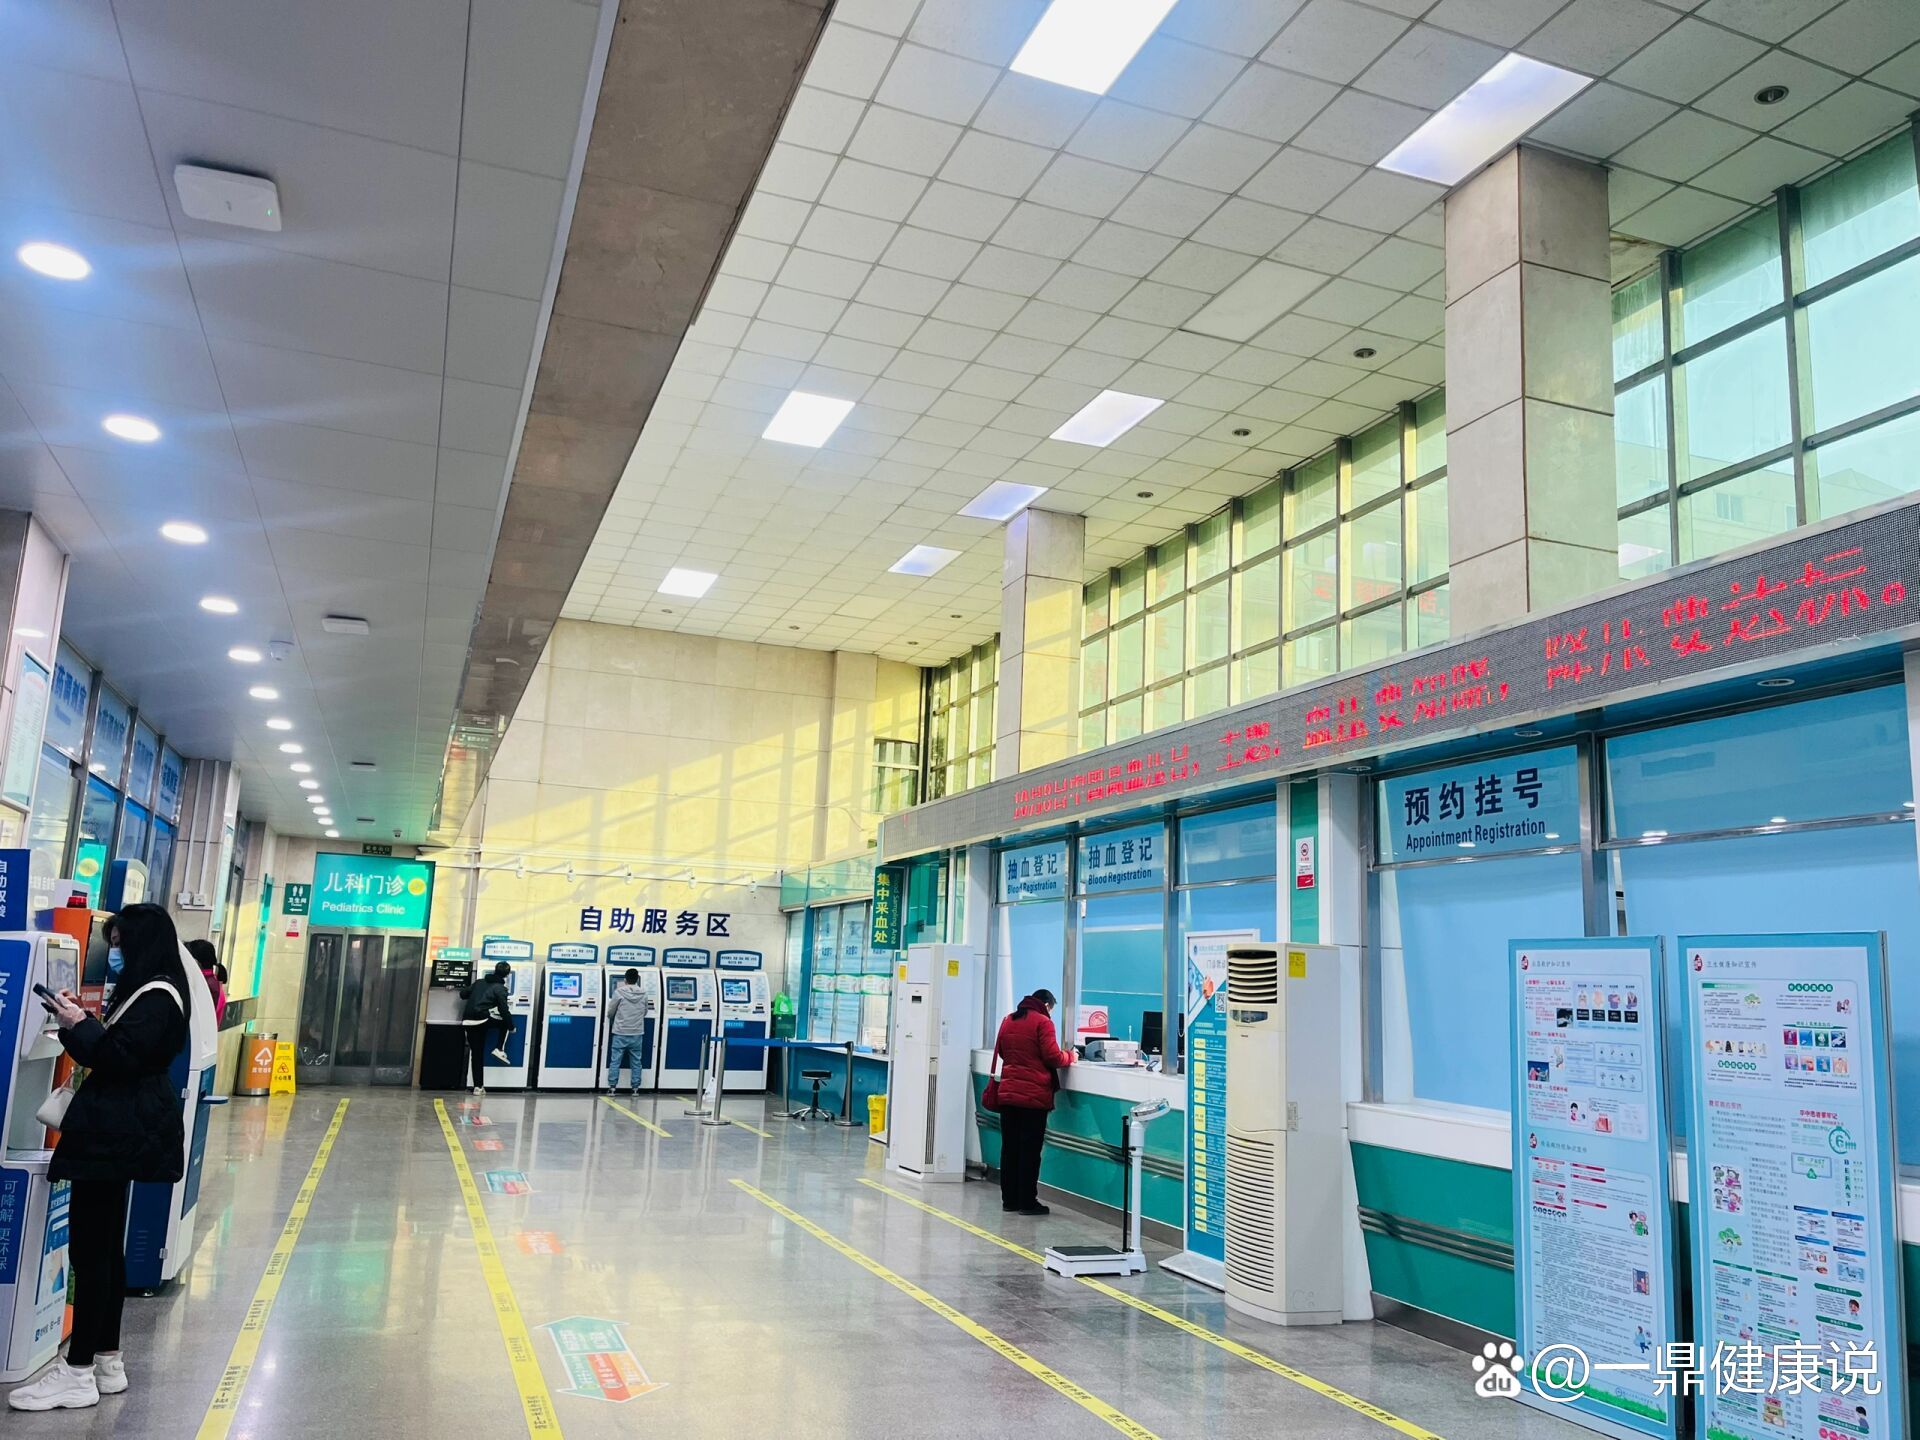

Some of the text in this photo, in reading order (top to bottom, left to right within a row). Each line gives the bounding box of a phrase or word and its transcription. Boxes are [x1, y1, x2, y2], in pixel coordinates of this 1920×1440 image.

[1404, 767, 1543, 826] 预约挂号
[1405, 818, 1546, 853] Appointment Registration
[1007, 853, 1058, 880] 抽血登记
[1088, 837, 1153, 869] 抽血登记
[323, 872, 405, 897] 儿科门诊
[1007, 880, 1057, 895] Blood Registration
[1088, 867, 1152, 886] Blood Registration
[321, 901, 406, 915] Pediatrics Clinic
[579, 905, 732, 938] 自助服务区
[874, 872, 891, 944] 集中采血处
[891, 895, 900, 926] Sampling
